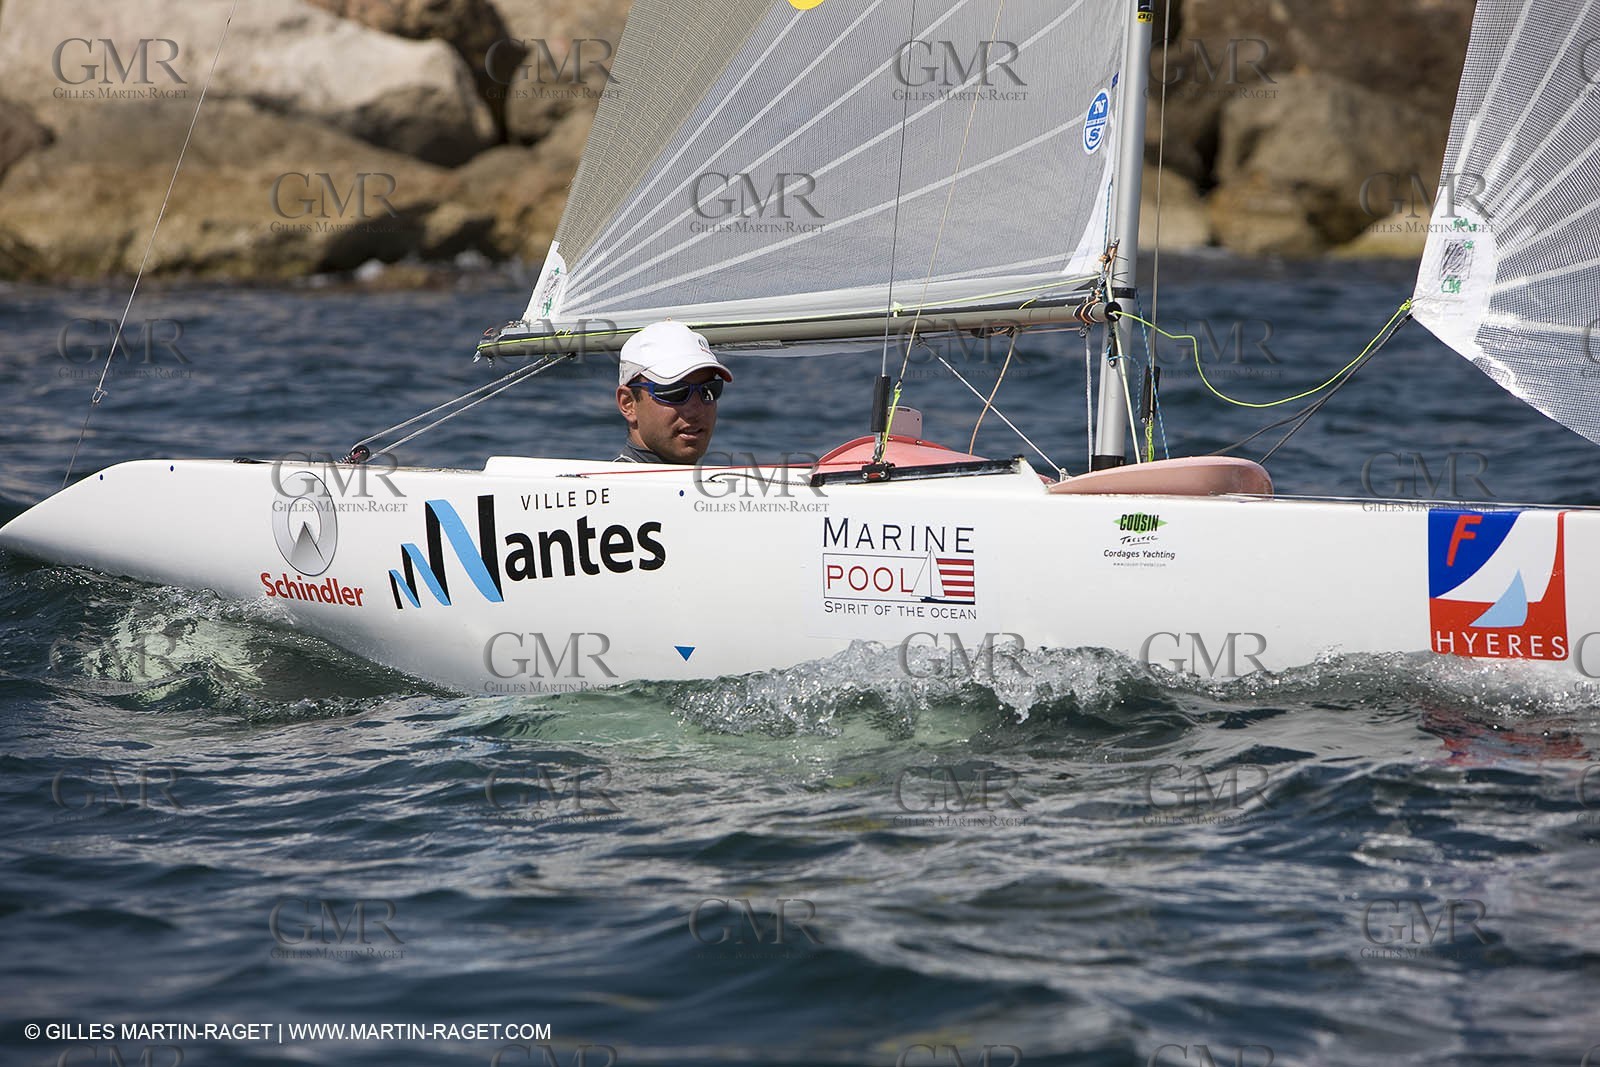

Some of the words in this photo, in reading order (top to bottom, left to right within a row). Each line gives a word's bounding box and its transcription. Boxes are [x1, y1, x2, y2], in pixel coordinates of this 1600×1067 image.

[1094, 100, 1106, 115] N
[1089, 128, 1100, 142] S
[521, 491, 576, 511] VILLE
[586, 488, 610, 506] DE
[1120, 514, 1159, 531] COUSIN
[823, 517, 974, 554] MARINE
[1446, 515, 1483, 567] F
[424, 494, 667, 603] Nantes
[1104, 549, 1140, 559] Cordages
[1142, 550, 1175, 560] Yachting
[260, 572, 363, 607] Schindler
[827, 565, 914, 593] POOL
[824, 601, 868, 615] SPIRIT
[874, 605, 892, 616] OF
[897, 606, 925, 618] THE
[931, 607, 977, 620] OCEAN
[1436, 631, 1566, 658] HYERES
